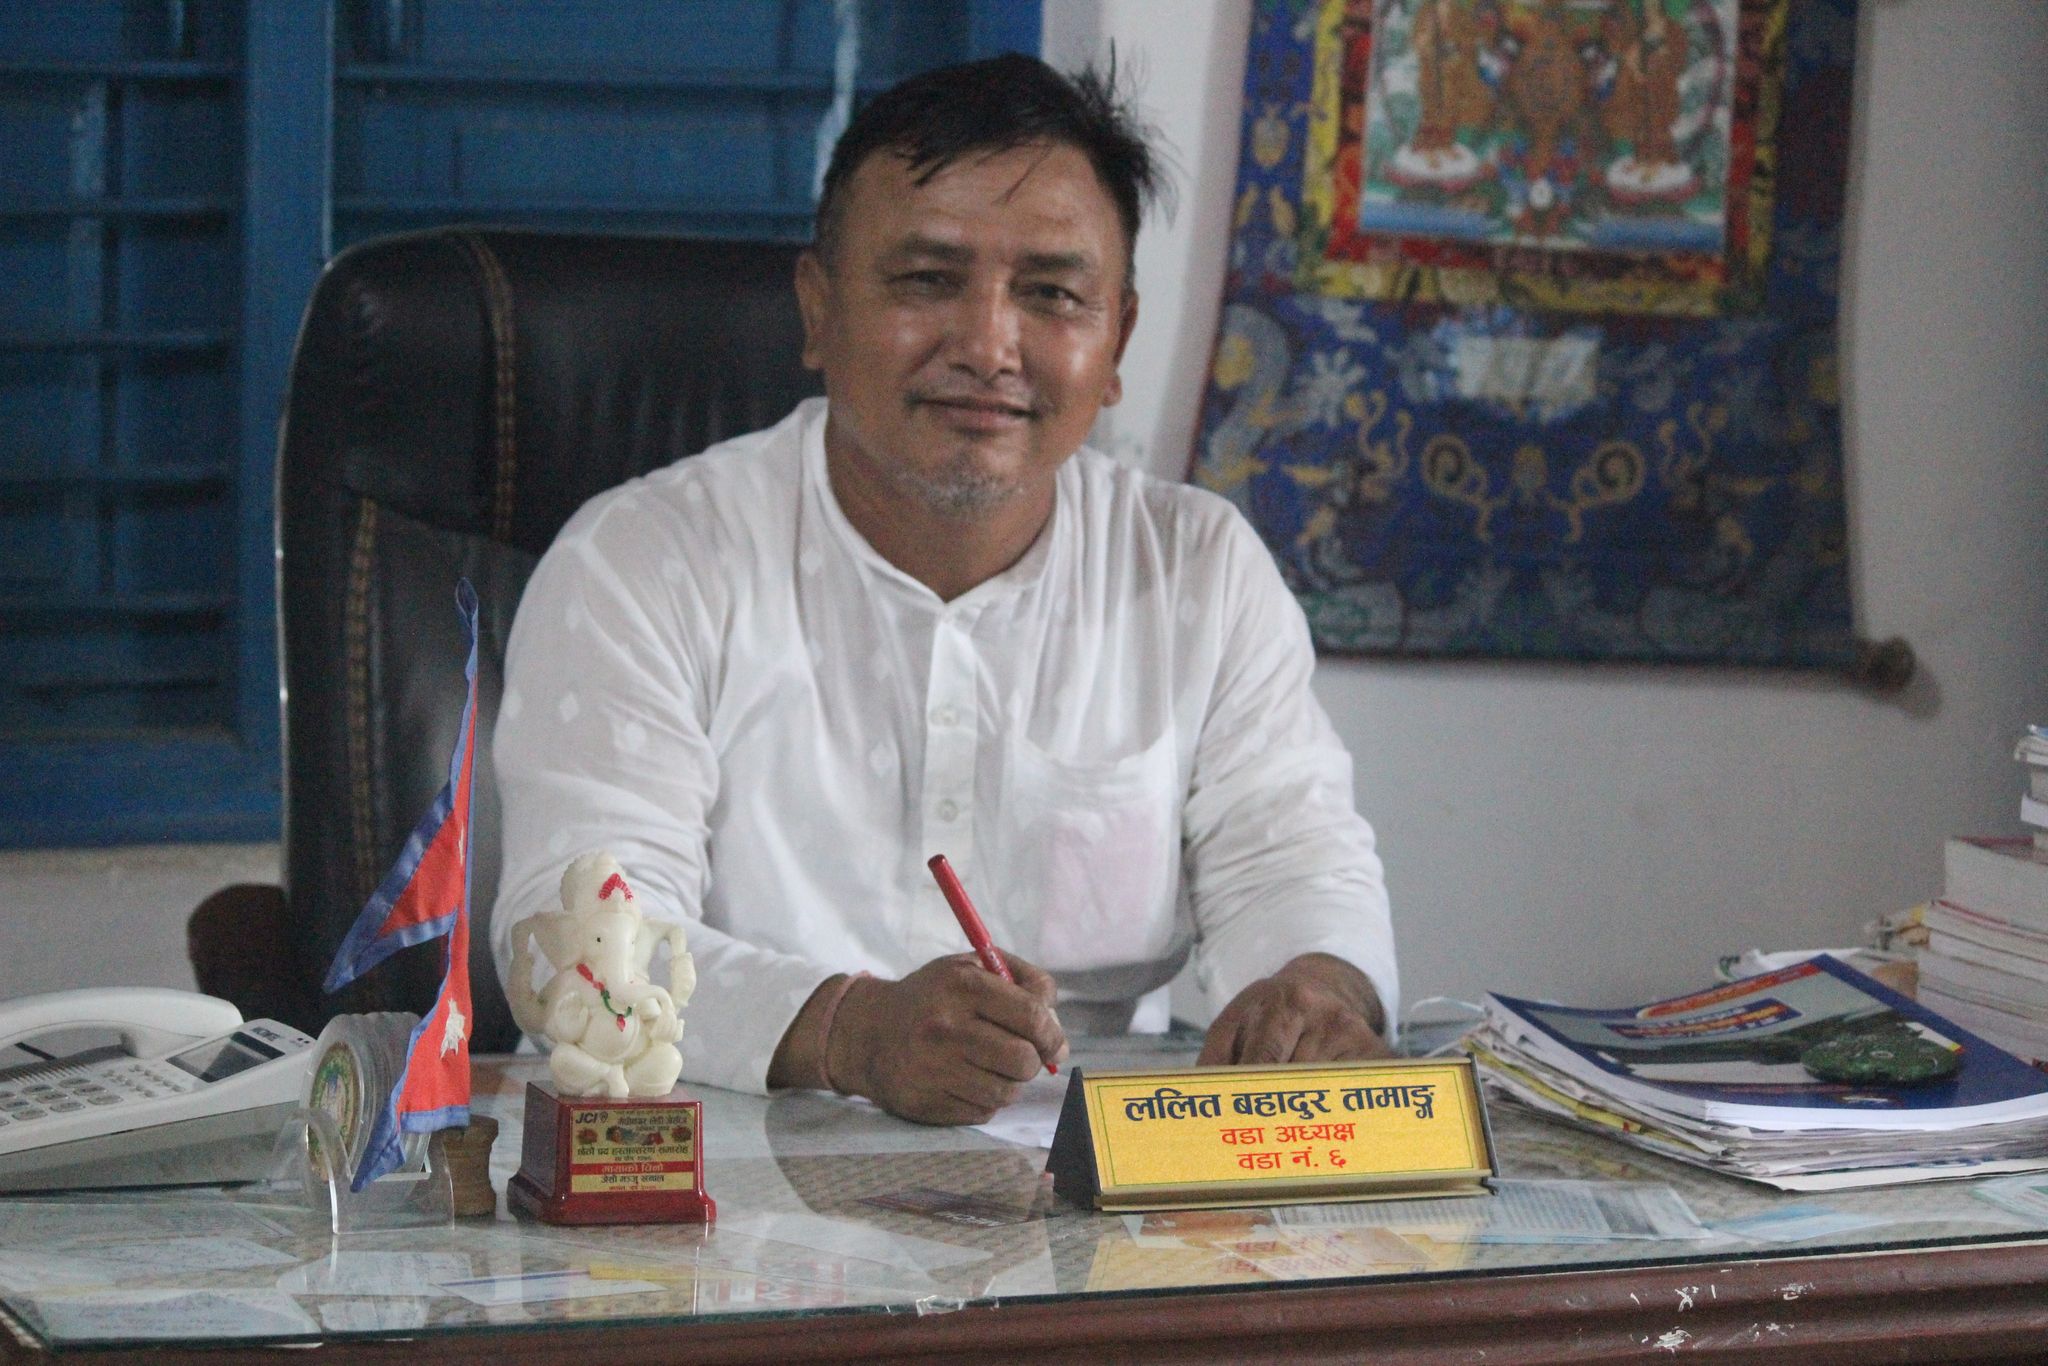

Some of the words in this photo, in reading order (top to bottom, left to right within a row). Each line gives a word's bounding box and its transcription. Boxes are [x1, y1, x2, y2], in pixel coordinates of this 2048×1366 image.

[1122, 1087, 1222, 1121] ललित
[1231, 1089, 1332, 1120] बहादुर
[576, 1112, 597, 1124] JCI
[1219, 1127, 1265, 1145] वडा
[1275, 1122, 1356, 1143] अध्यक्ष
[1236, 1152, 1283, 1170] वडा
[1290, 1146, 1319, 1168] नं.
[1328, 1149, 1347, 1168] ६
